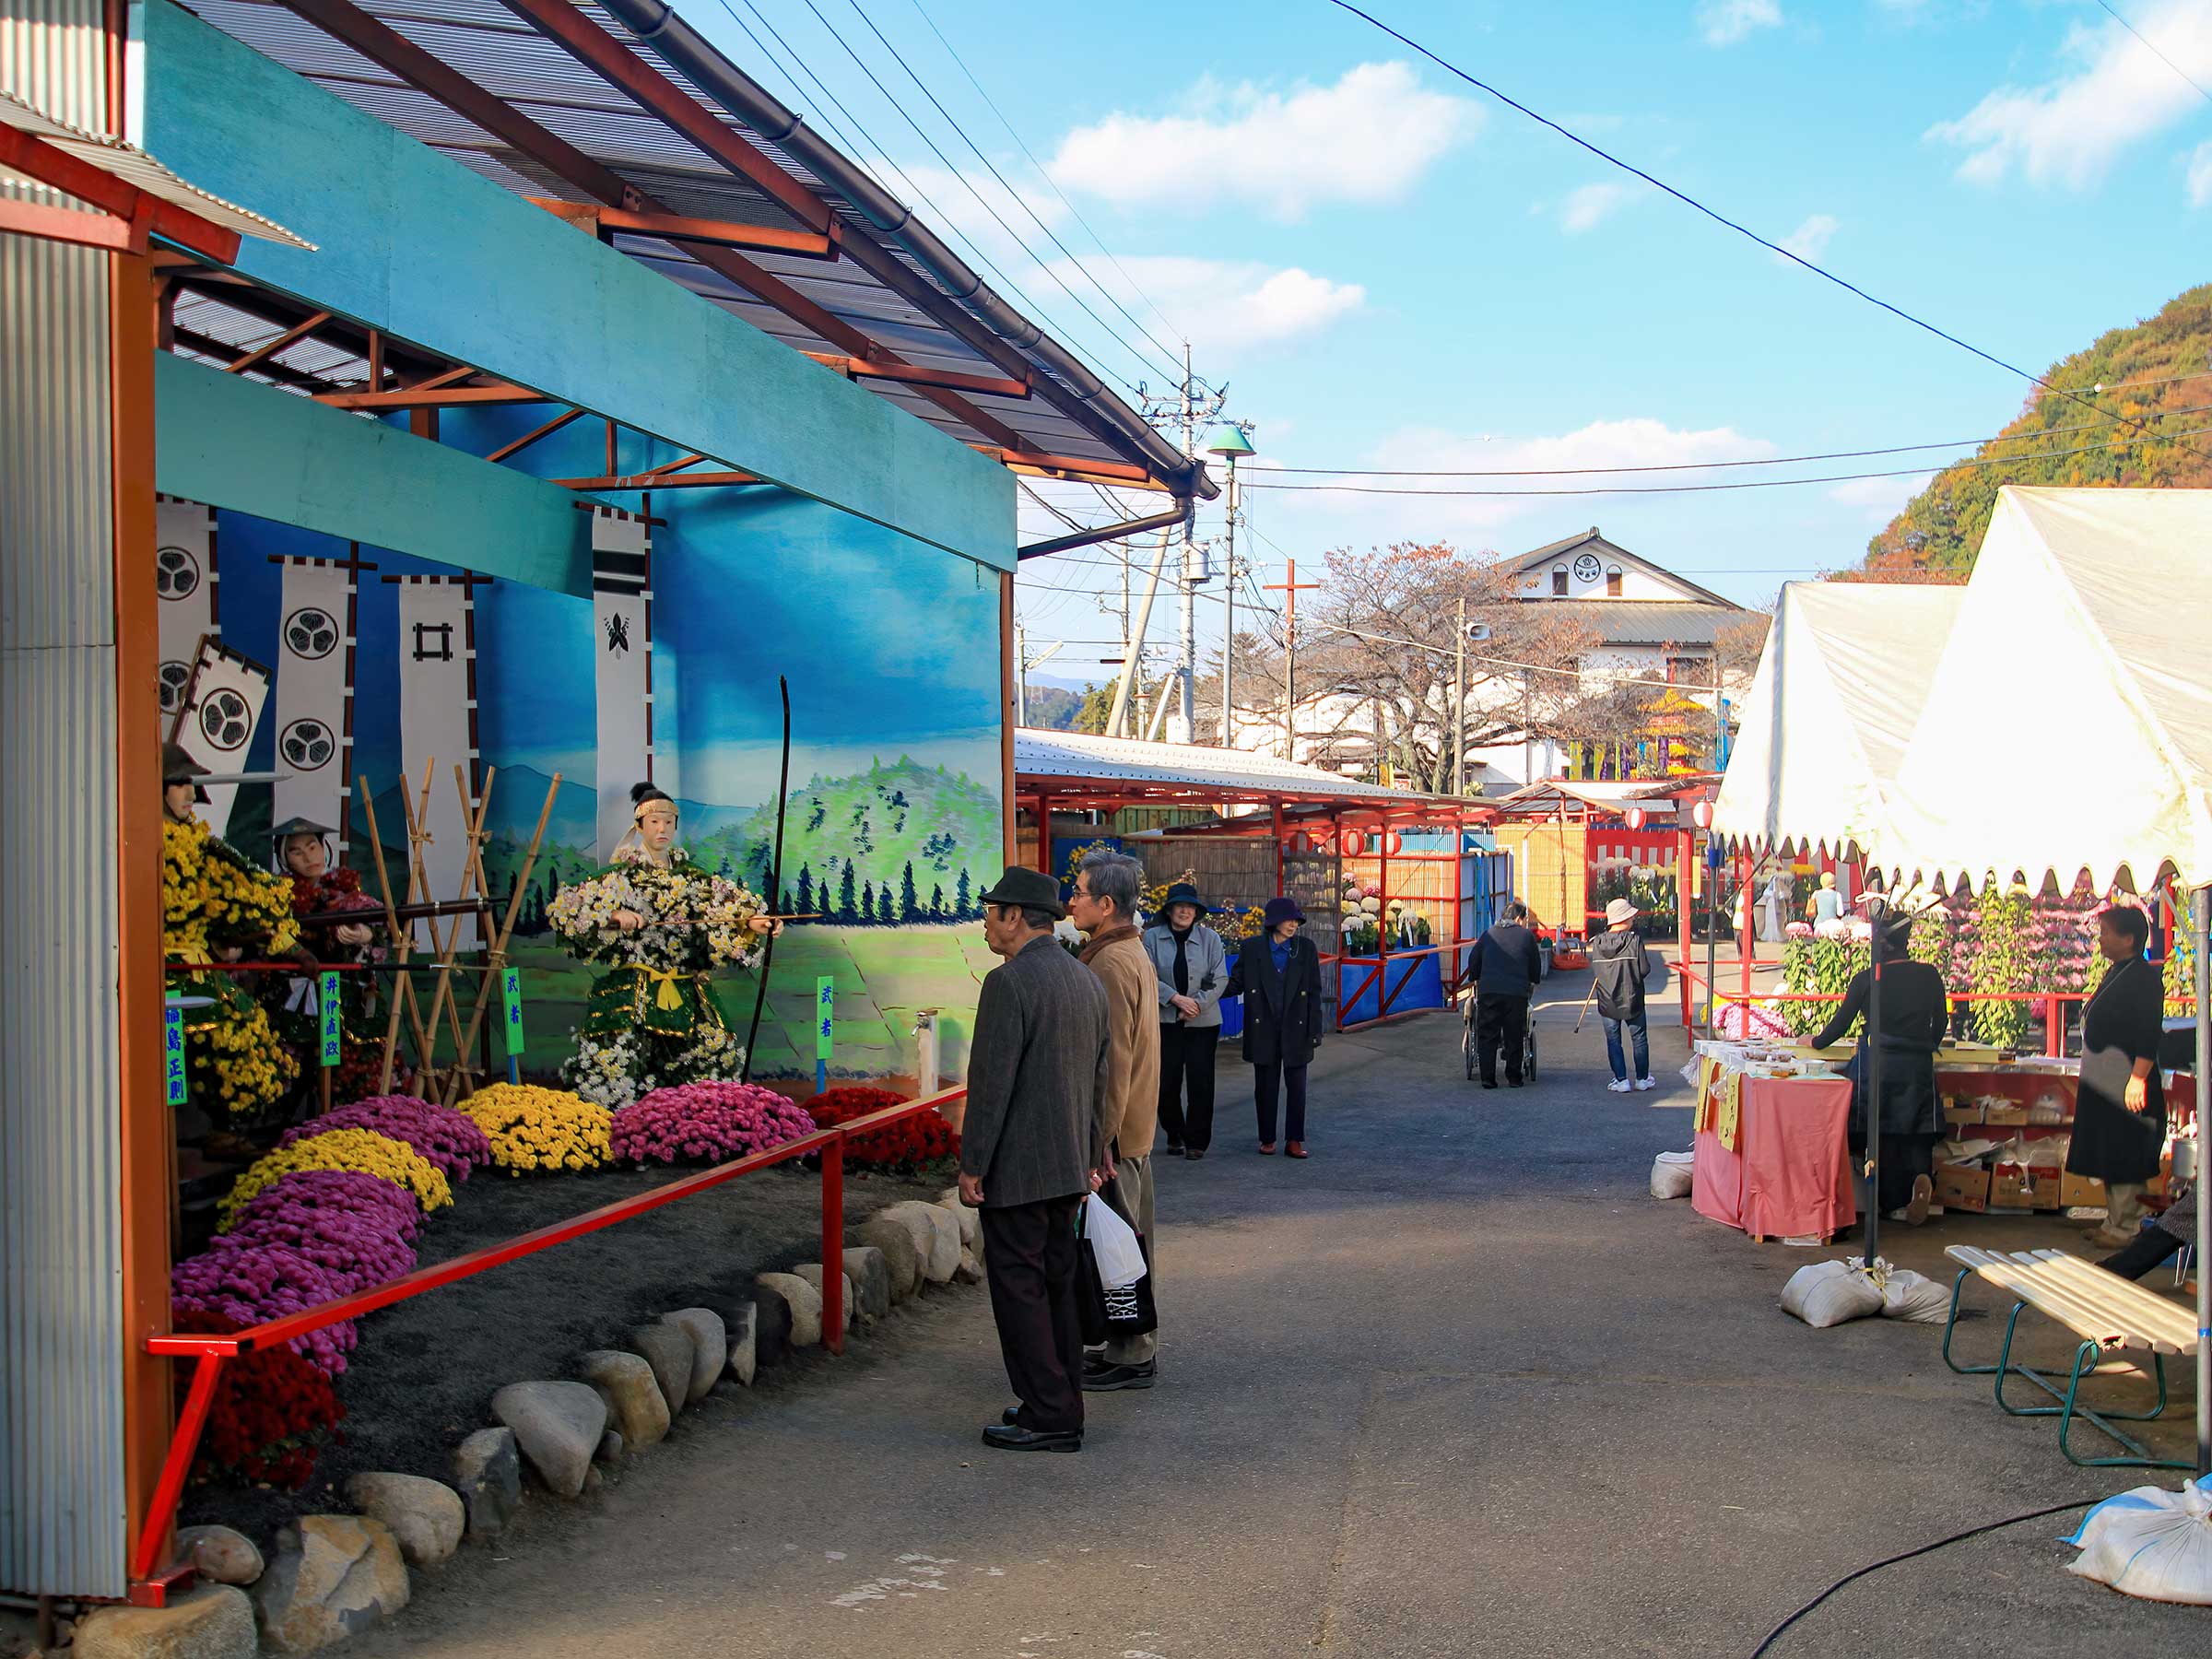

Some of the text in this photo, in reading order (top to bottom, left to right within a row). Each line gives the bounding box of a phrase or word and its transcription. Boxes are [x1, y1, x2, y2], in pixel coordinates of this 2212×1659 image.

[325, 976, 339, 1057] 井伊直政
[507, 975, 519, 1025] 武者
[820, 985, 832, 1037] 武者
